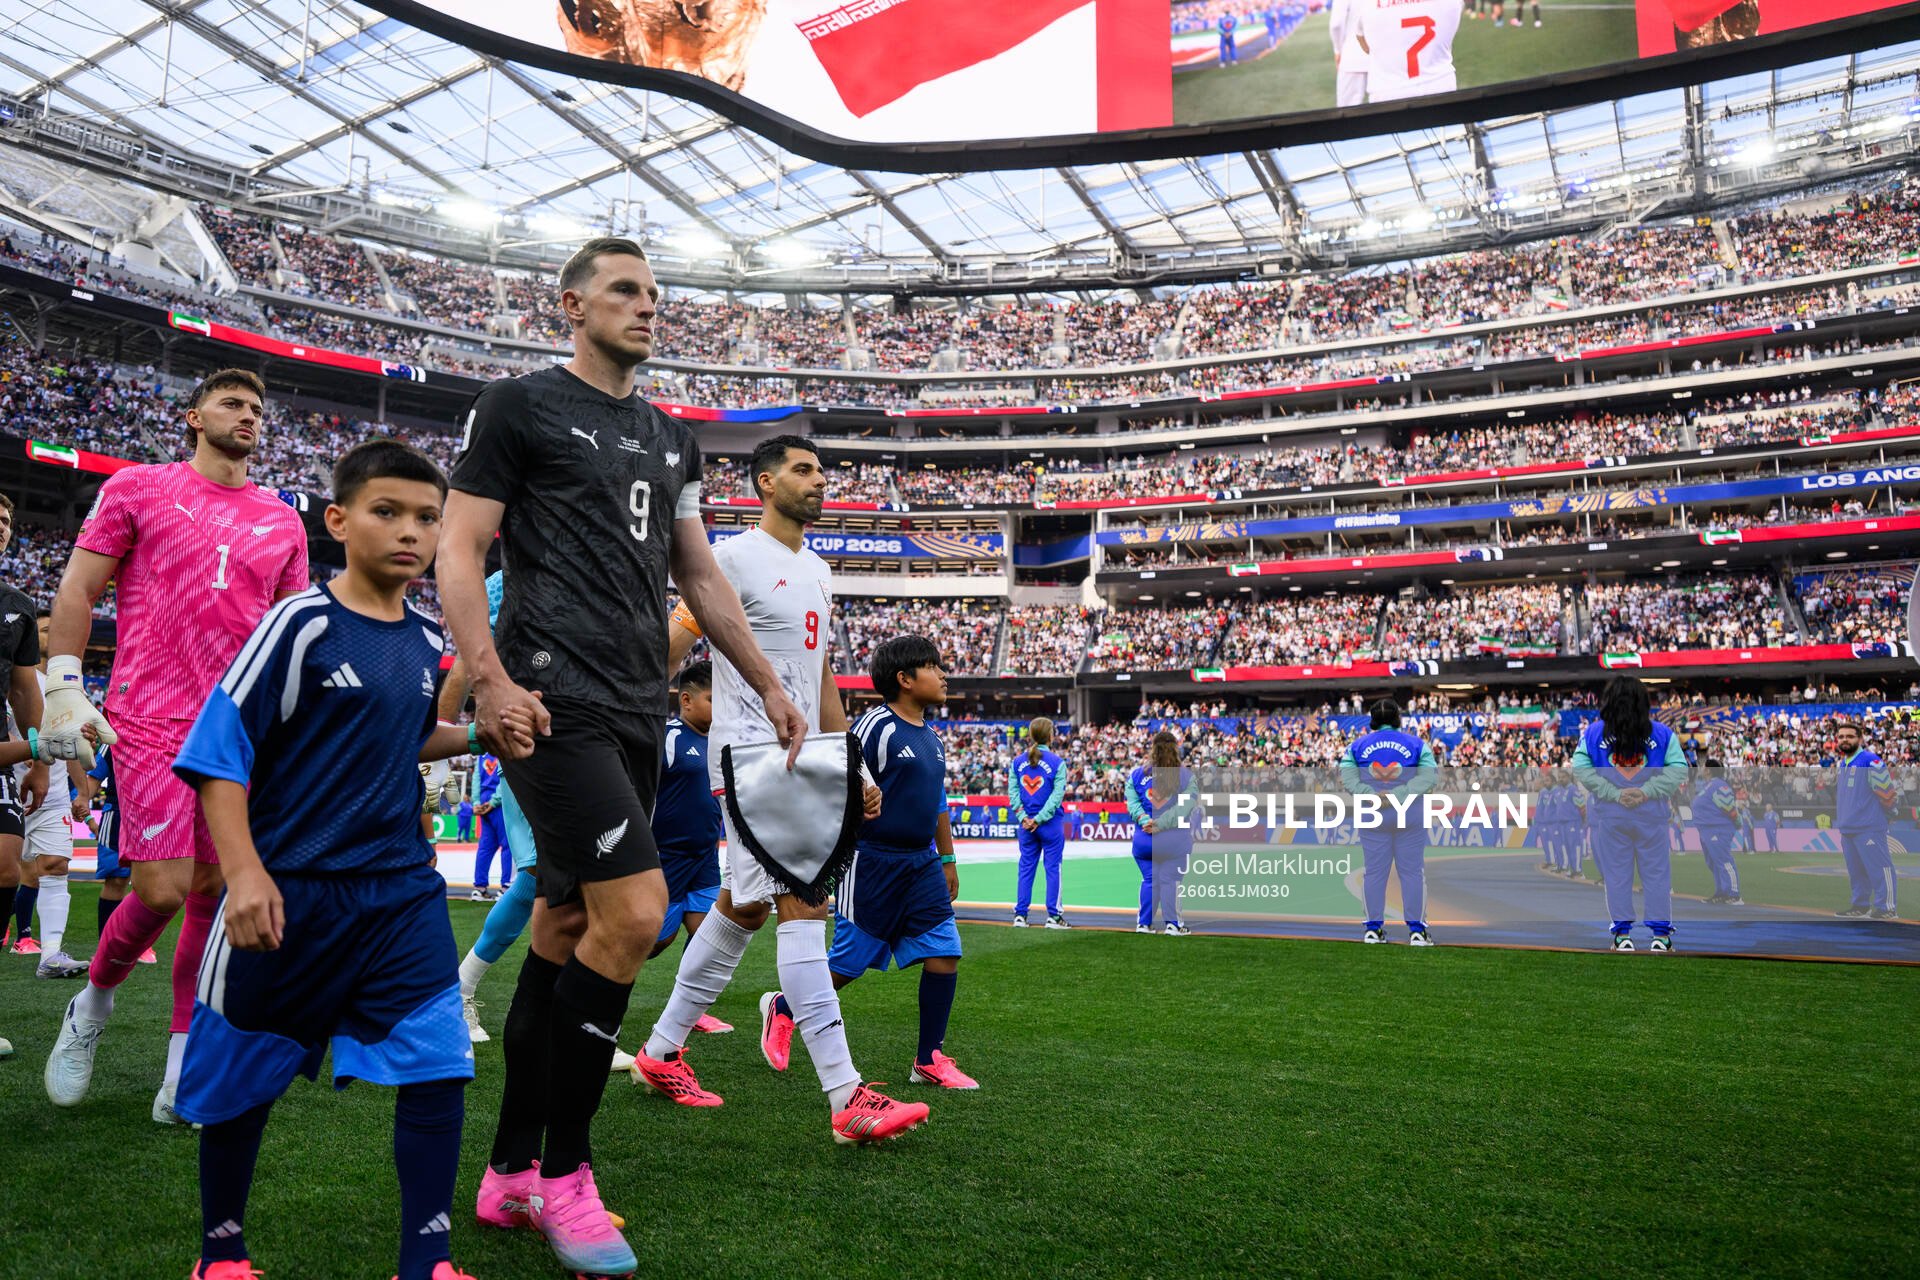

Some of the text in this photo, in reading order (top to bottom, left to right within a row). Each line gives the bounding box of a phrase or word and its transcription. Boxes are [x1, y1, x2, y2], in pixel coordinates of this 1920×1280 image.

[1401, 15, 1436, 79] 7
[1802, 472, 1857, 490] LOS
[629, 480, 651, 541] 9
[812, 536, 842, 551] CUP
[846, 539, 902, 553] 2026
[211, 544, 230, 591] 1
[804, 610, 819, 651] 9
[1361, 741, 1412, 760] VOLUNTEER
[1017, 760, 1053, 775] VOLTEER
[1080, 823, 1136, 841] QATAR
